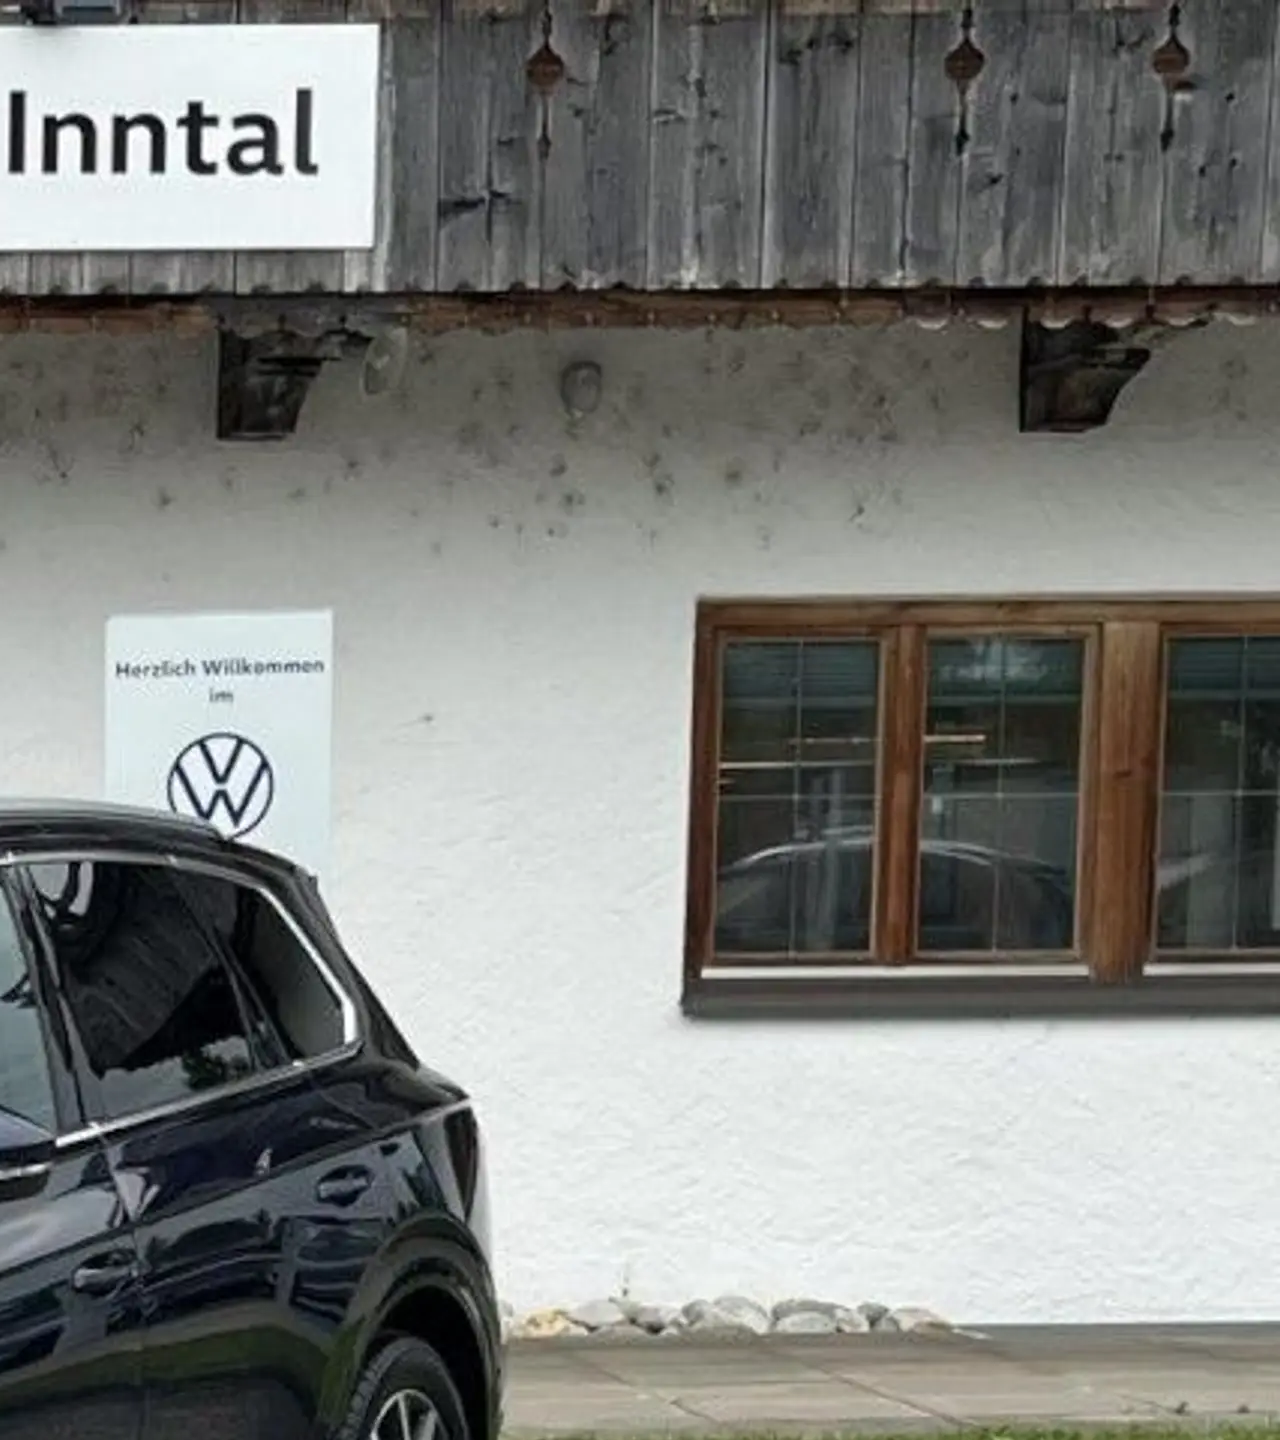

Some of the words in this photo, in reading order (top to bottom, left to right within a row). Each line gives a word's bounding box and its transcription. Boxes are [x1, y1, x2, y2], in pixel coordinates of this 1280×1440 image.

[7, 89, 319, 175] Inntal
[114, 659, 196, 679] Herzlich
[200, 657, 325, 677] Willkommen
[208, 687, 234, 703] im
